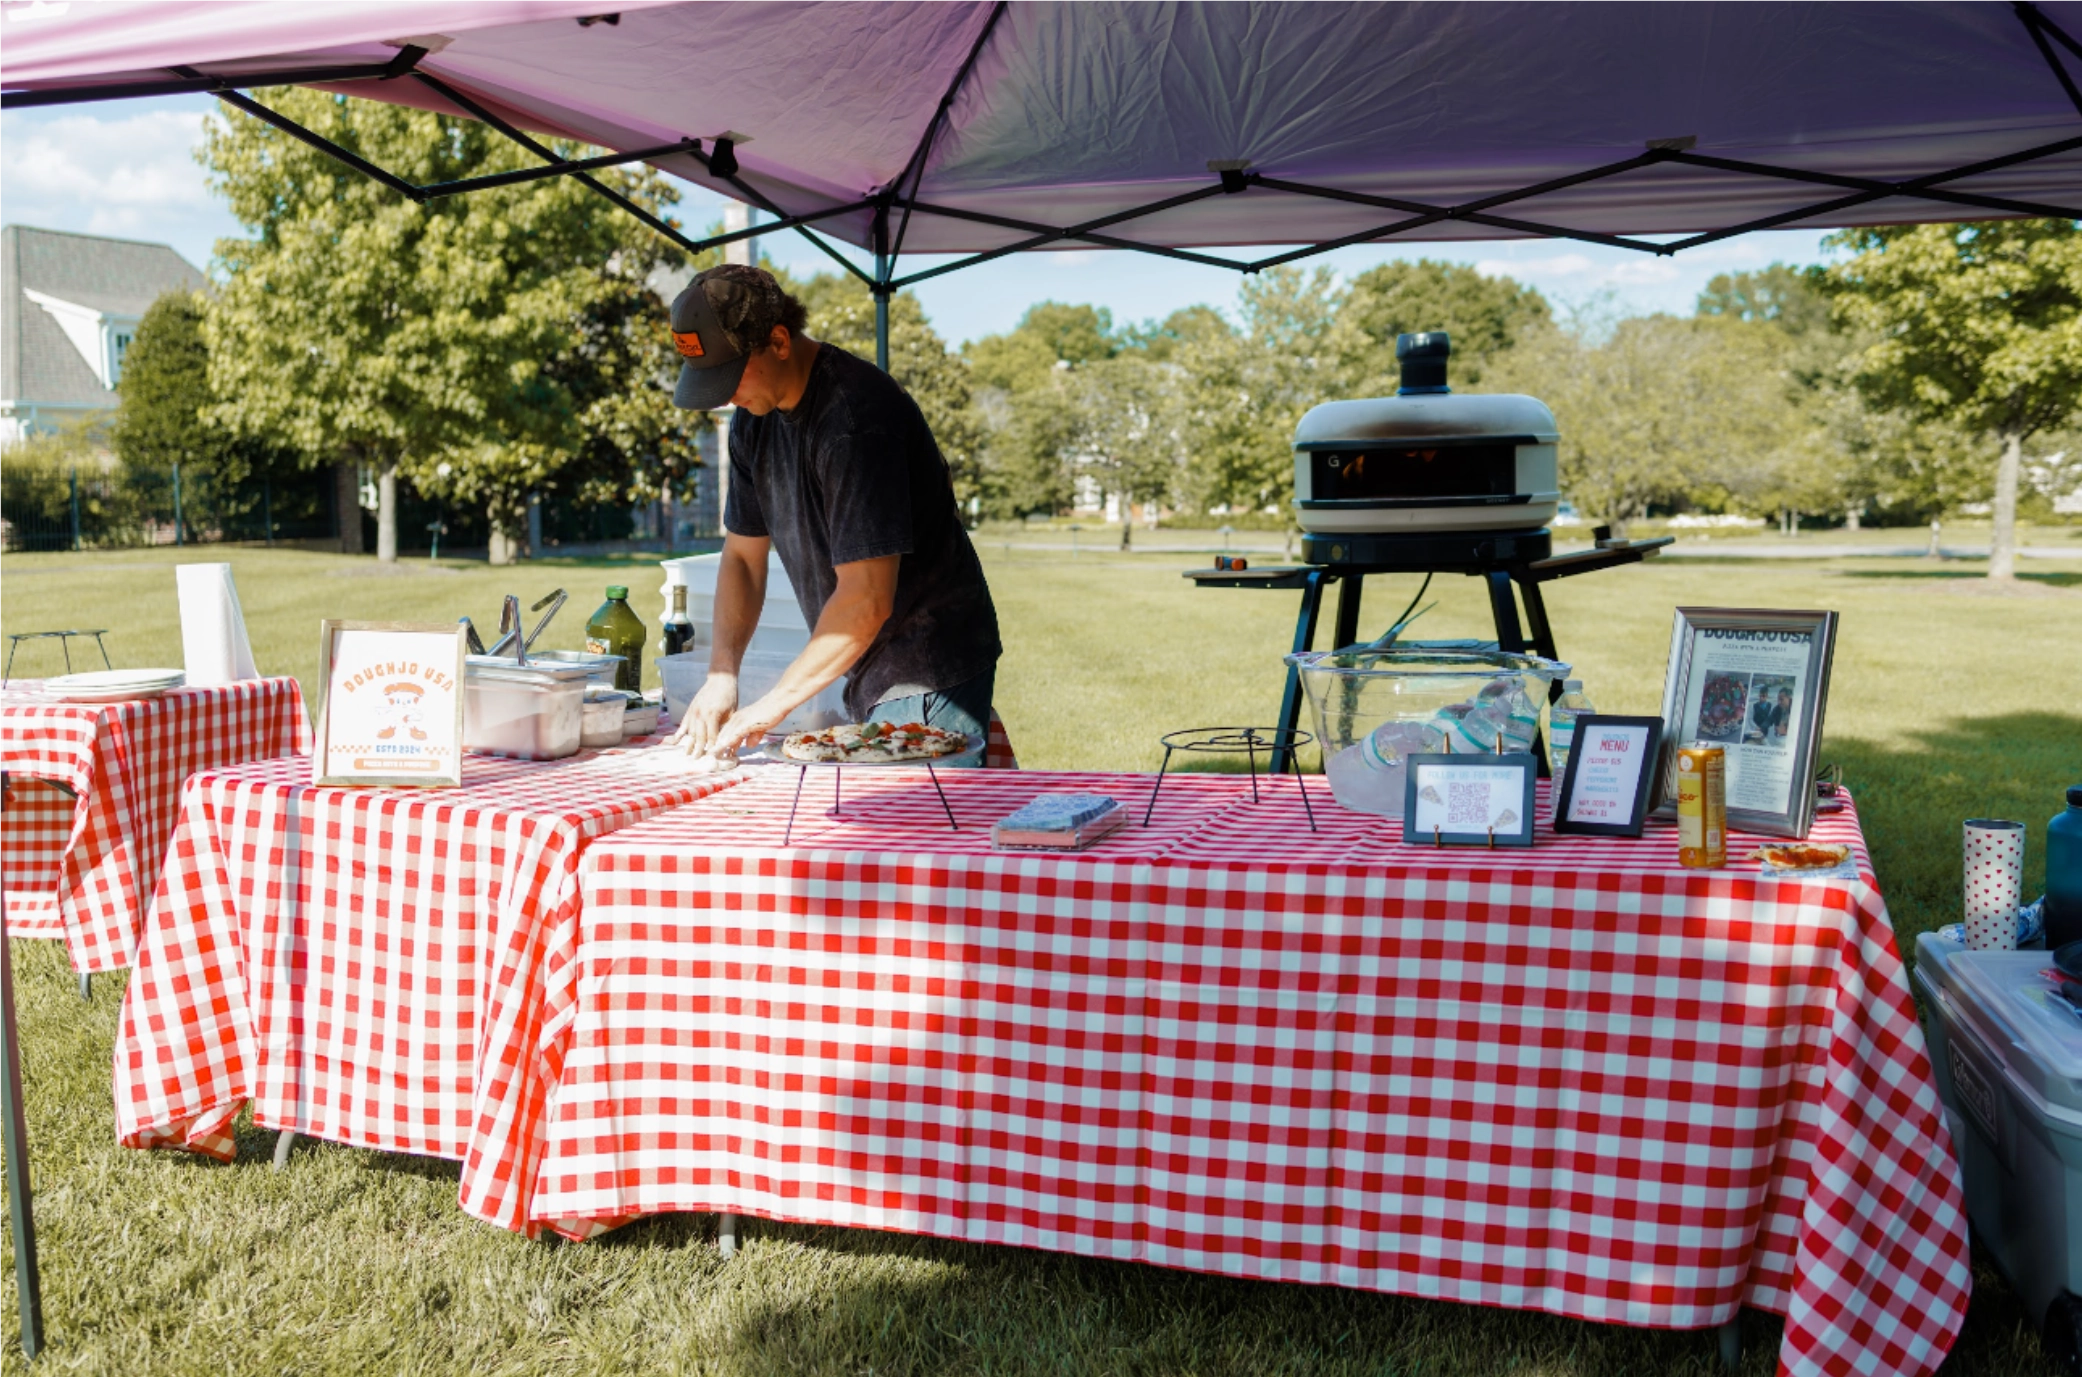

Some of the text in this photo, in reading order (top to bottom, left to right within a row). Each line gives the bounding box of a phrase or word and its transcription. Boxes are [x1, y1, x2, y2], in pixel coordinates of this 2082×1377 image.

[1328, 455, 1339, 467] G
[1780, 631, 1812, 644] USA
[343, 661, 454, 693] DOUGHJO USA
[1600, 740, 1630, 752] MENU
